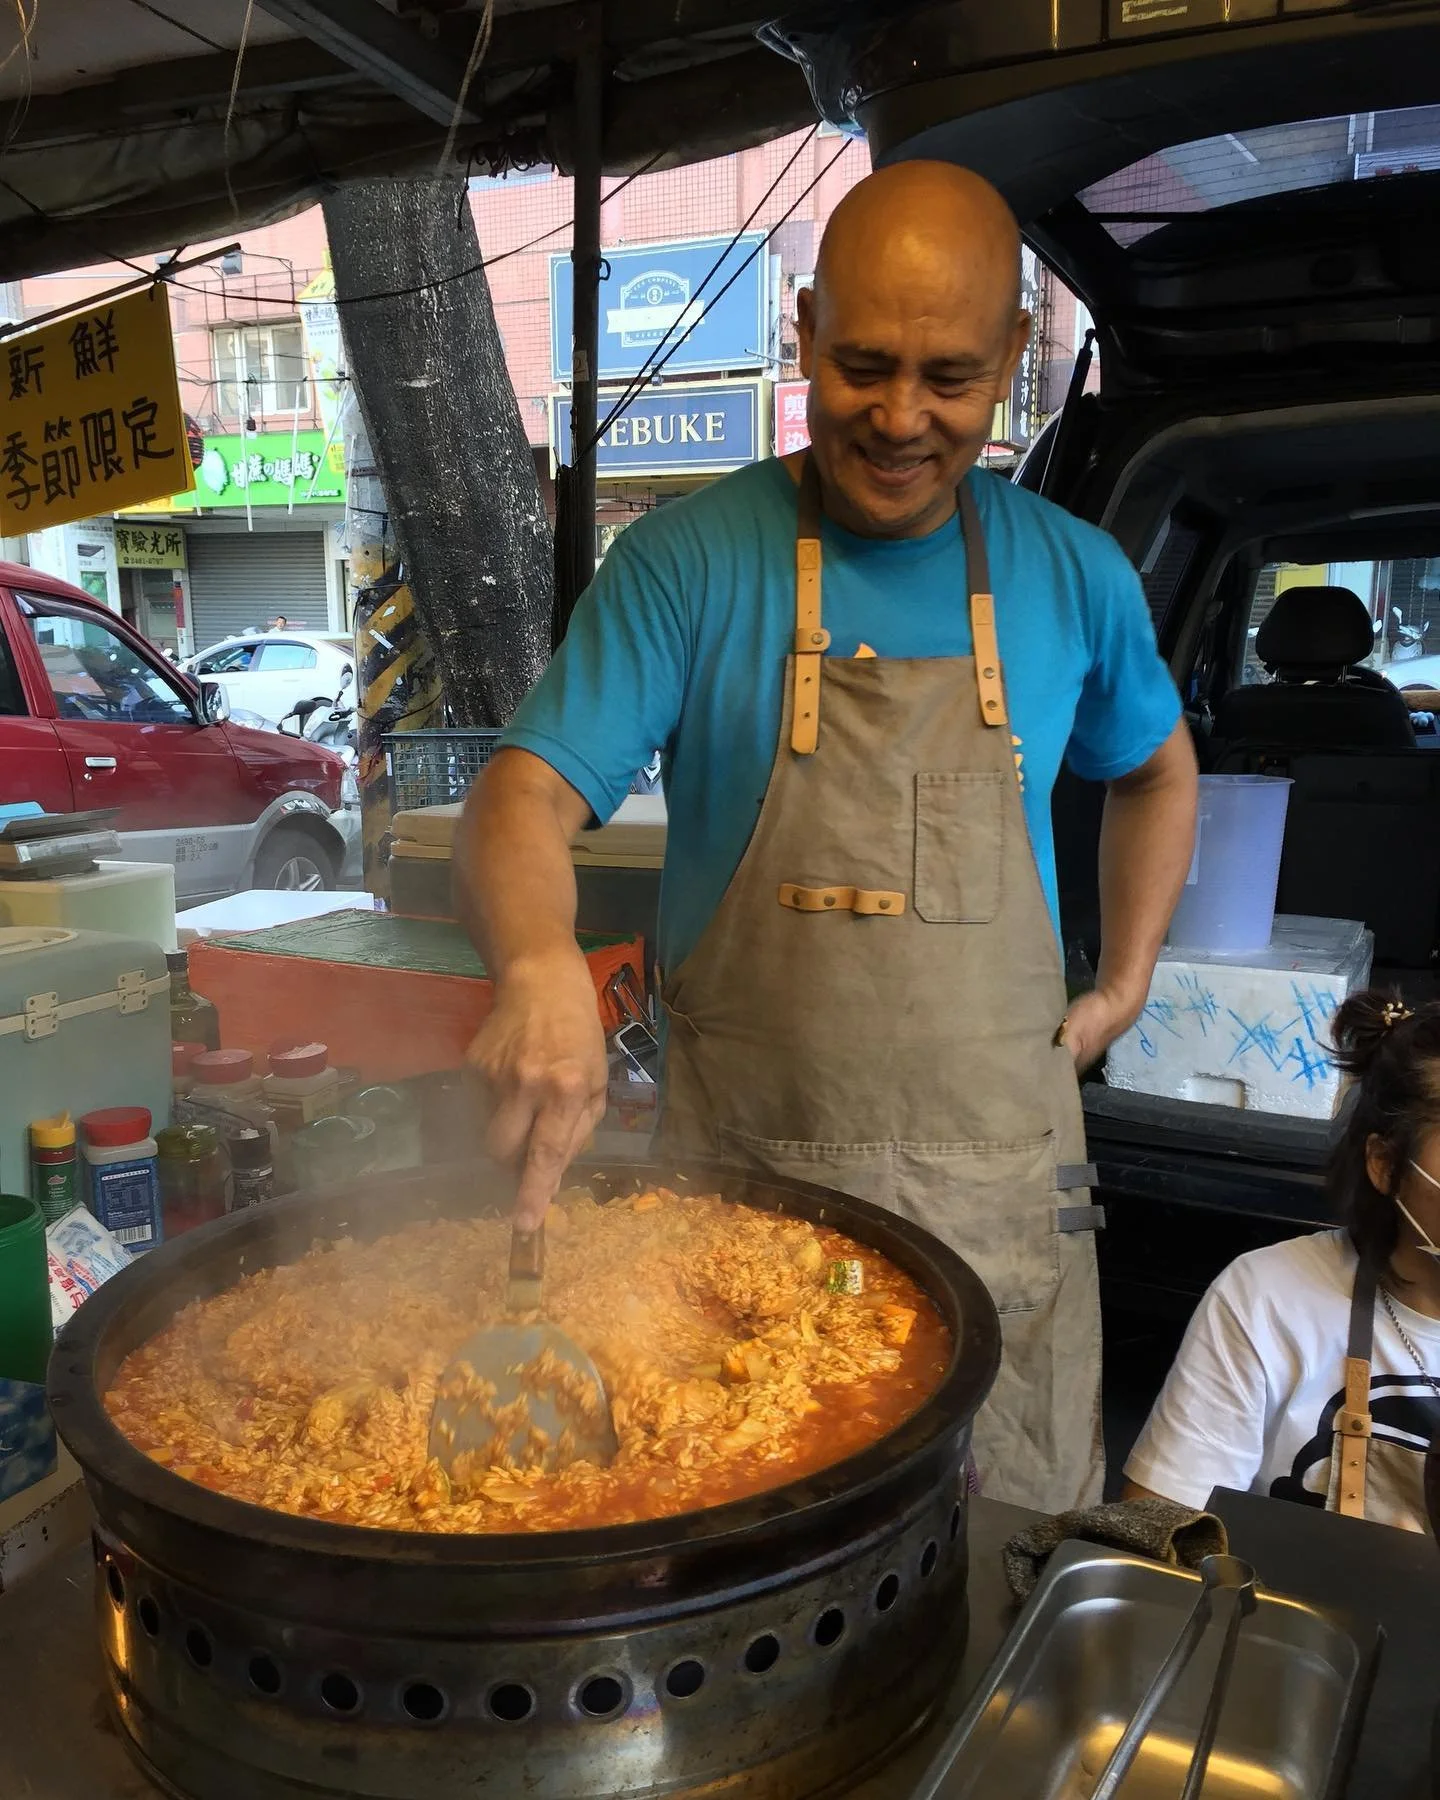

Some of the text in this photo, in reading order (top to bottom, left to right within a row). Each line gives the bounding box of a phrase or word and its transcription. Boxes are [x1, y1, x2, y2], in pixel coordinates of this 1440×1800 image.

[8, 308, 120, 401] 新鮮
[0, 396, 175, 511] 季節限定
